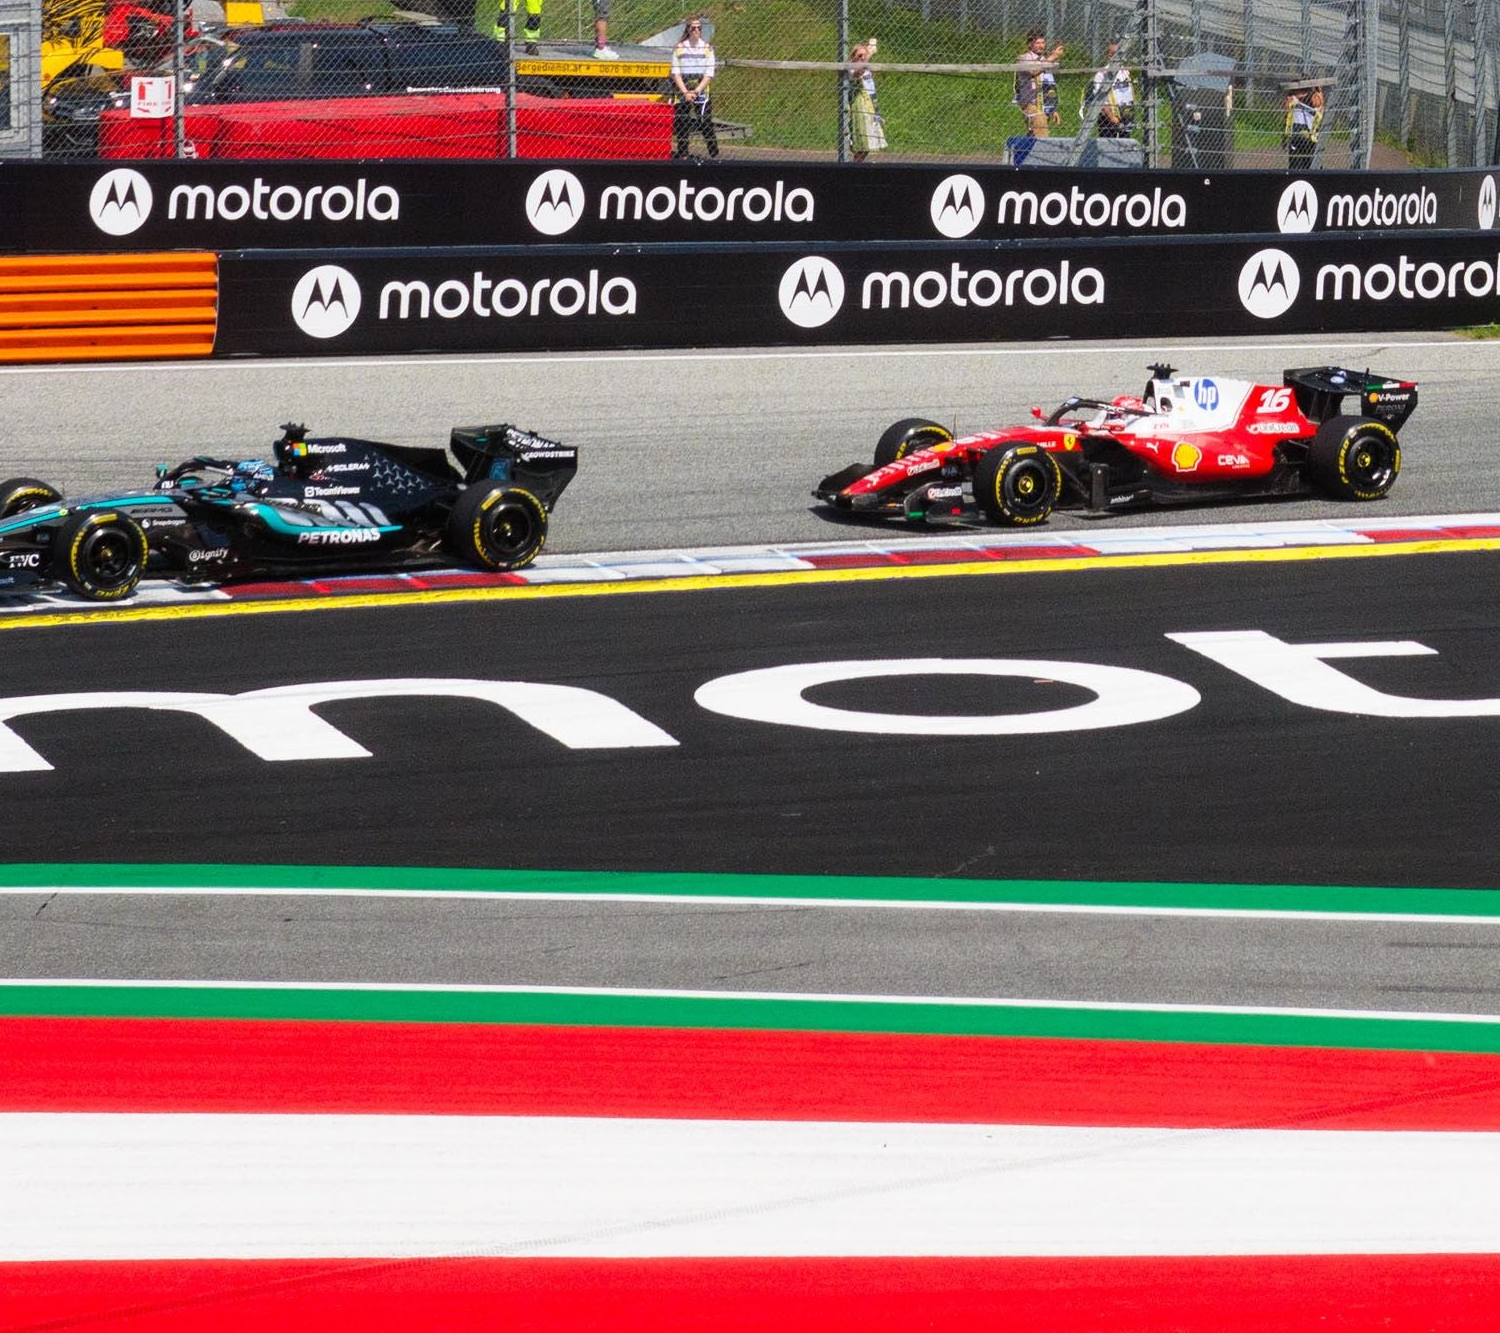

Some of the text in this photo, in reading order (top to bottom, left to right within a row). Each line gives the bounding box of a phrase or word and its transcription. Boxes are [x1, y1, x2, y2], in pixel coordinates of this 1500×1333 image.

[167, 177, 400, 221] motorola
[600, 179, 815, 222] motorola
[997, 185, 1187, 228] motorola
[1326, 185, 1438, 227] motorola
[380, 269, 637, 320] motorola
[861, 260, 1105, 310] motorola
[1198, 381, 1216, 410] hp
[1256, 388, 1292, 413] 16
[1378, 393, 1410, 402] V-Power
[1259, 422, 1300, 434] UniCredit
[308, 443, 346, 453] Microsoft
[1217, 454, 1250, 465] CEVA
[315, 485, 360, 496] TeamViewer
[153, 519, 186, 528] Snapdragon
[298, 528, 380, 544] PETRONAS
